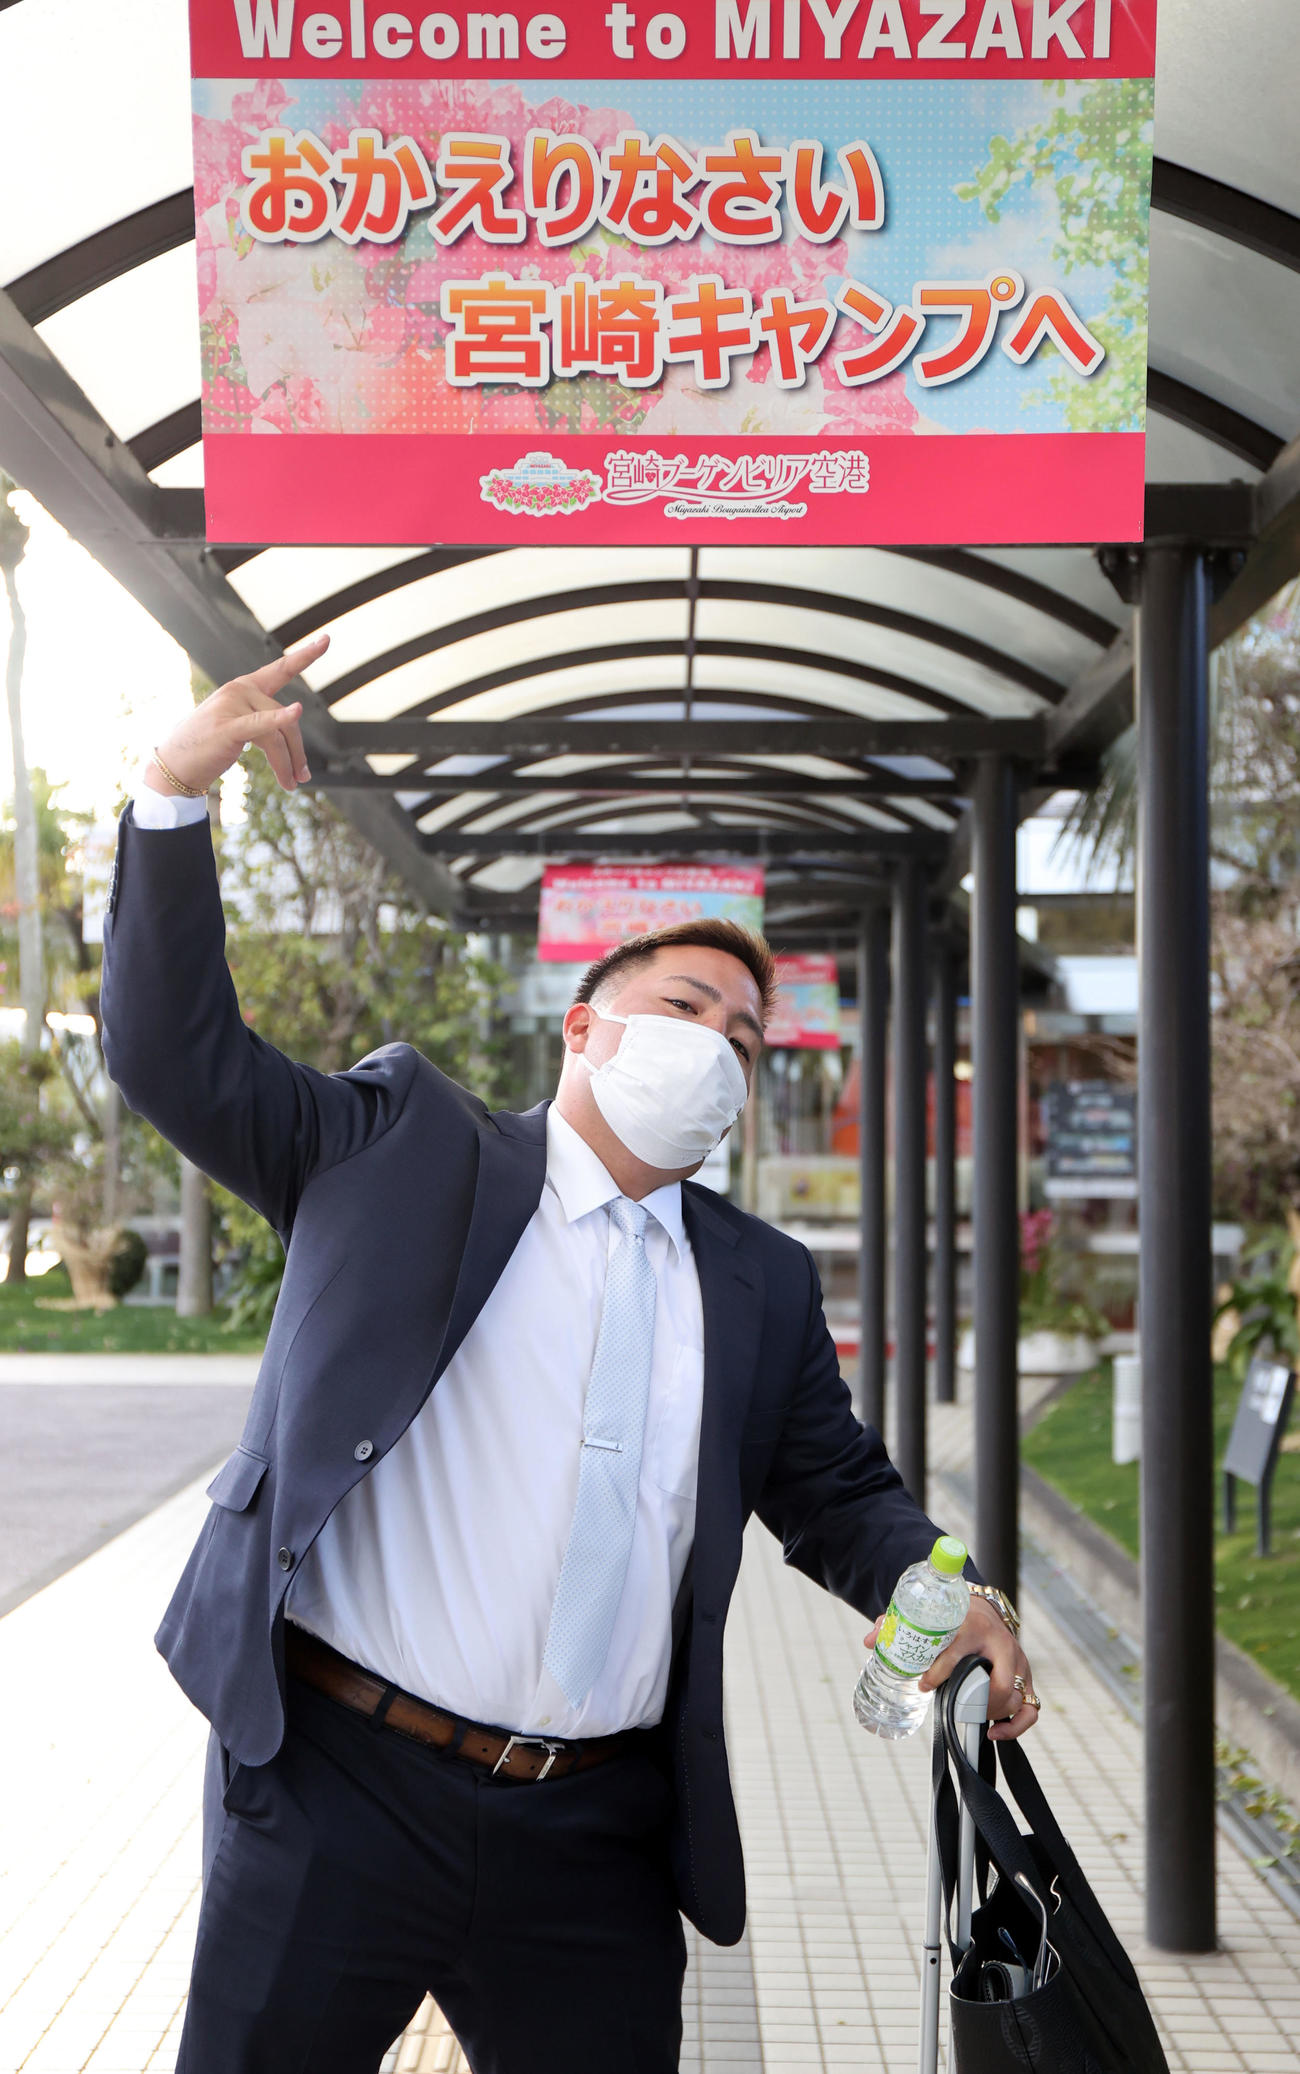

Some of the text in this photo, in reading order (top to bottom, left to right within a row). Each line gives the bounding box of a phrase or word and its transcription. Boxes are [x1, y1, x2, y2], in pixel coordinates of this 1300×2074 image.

[234, 0, 1112, 60] Welcome to MIYAZAKI
[243, 129, 883, 244] おかえりなさい
[443, 274, 1103, 385] 宮崎キャンプへ
[605, 451, 868, 497] 宮崎ブーゲンビリア空港
[667, 499, 804, 516] Miyazaki Bougainvillea Airport
